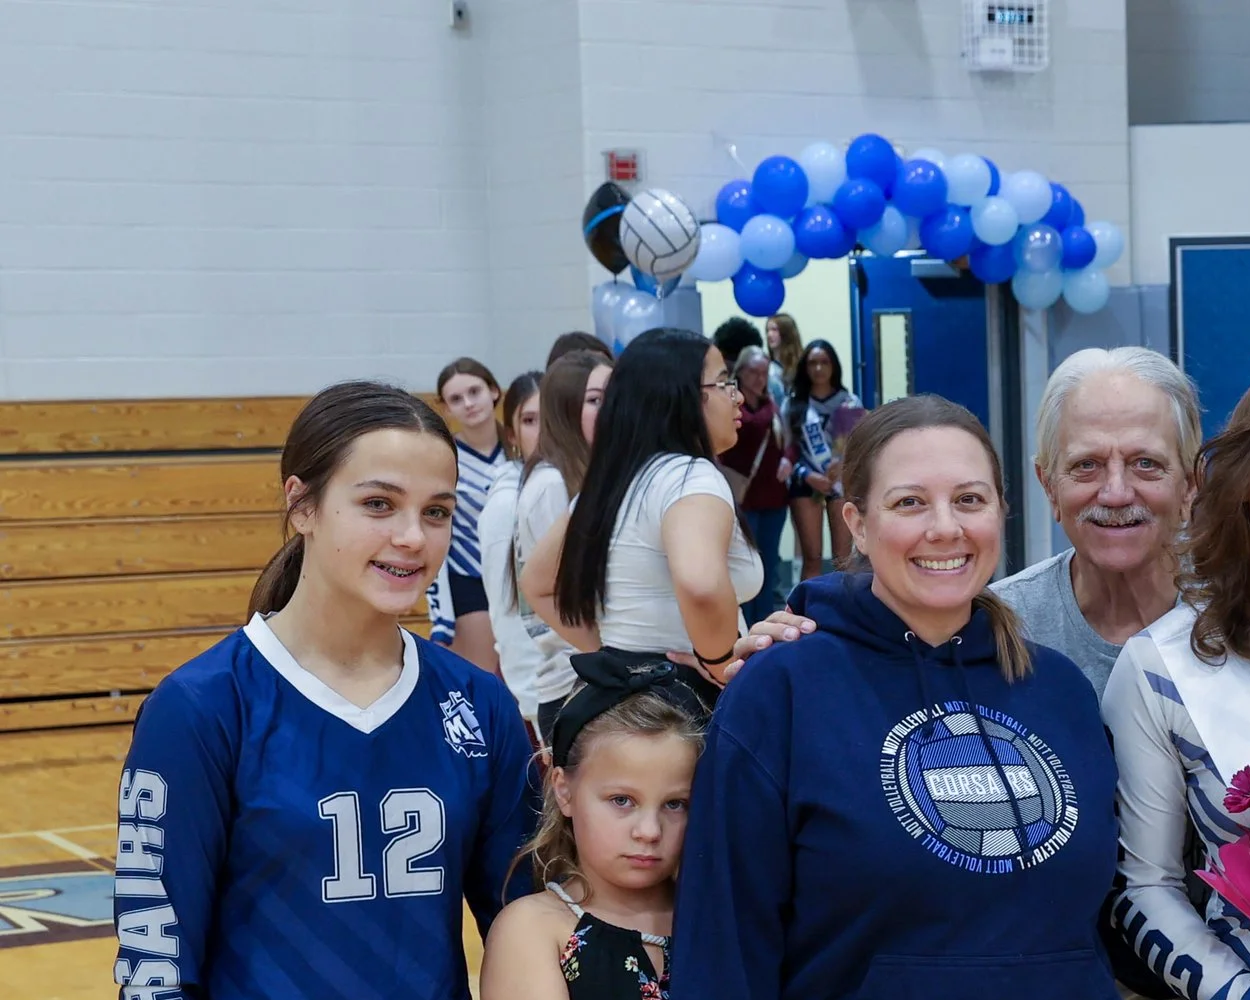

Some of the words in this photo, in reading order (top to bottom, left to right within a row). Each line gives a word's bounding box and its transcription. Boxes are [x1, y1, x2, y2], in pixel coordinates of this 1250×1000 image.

[893, 703, 945, 739] VOLLEYBLL
[976, 704, 1028, 737] OLLEYBALL
[880, 759, 906, 813] VOLLEYBALL
[928, 771, 1034, 797] CORSARS
[1027, 733, 1052, 755] MOTT
[1046, 753, 1078, 804] VOLLEYBALL
[897, 812, 925, 839] MOTT
[318, 788, 445, 903] 12
[921, 834, 982, 873] VOLLEYBALL
[985, 858, 1013, 874] MOTT
